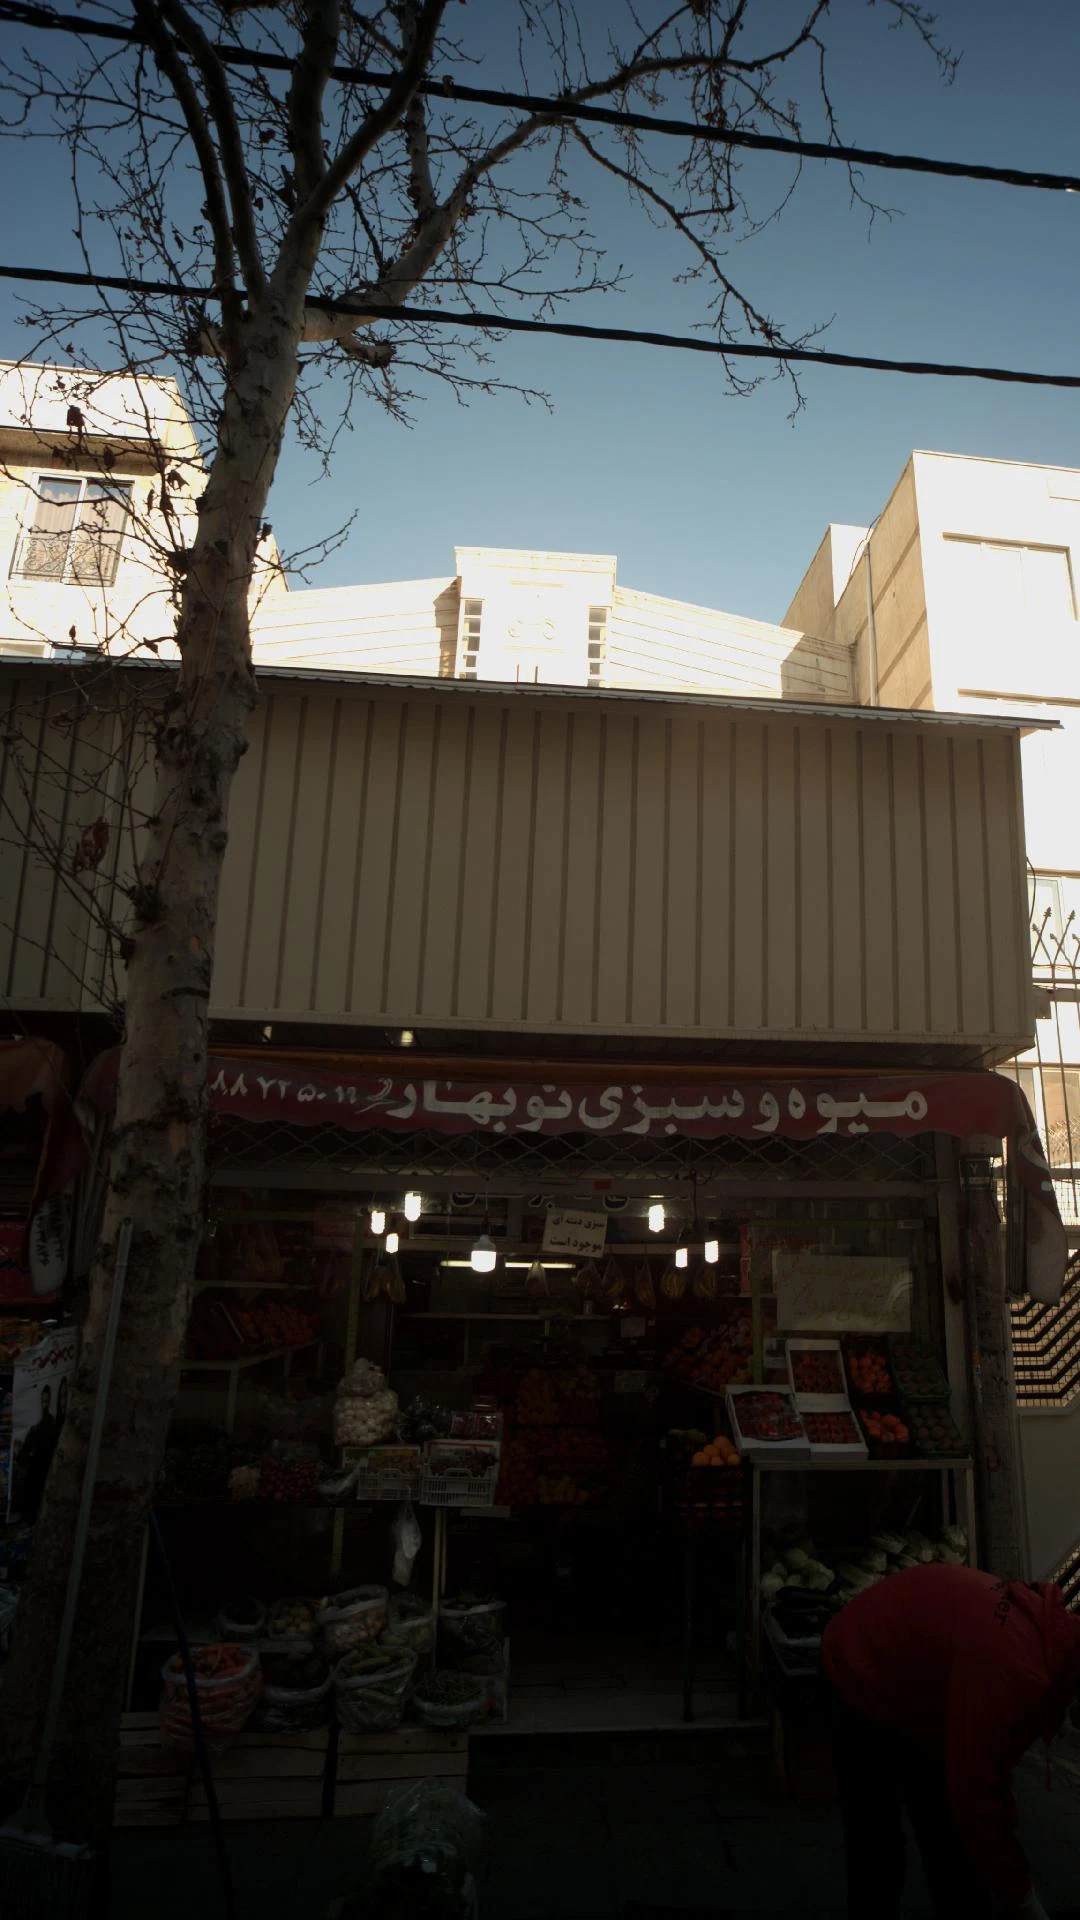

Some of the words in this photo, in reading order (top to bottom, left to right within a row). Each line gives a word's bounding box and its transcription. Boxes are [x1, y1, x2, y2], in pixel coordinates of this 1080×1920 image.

[578, 1084, 745, 1135] سبزی
[752, 1091, 780, 1133] و
[788, 1088, 928, 1133] میوه
